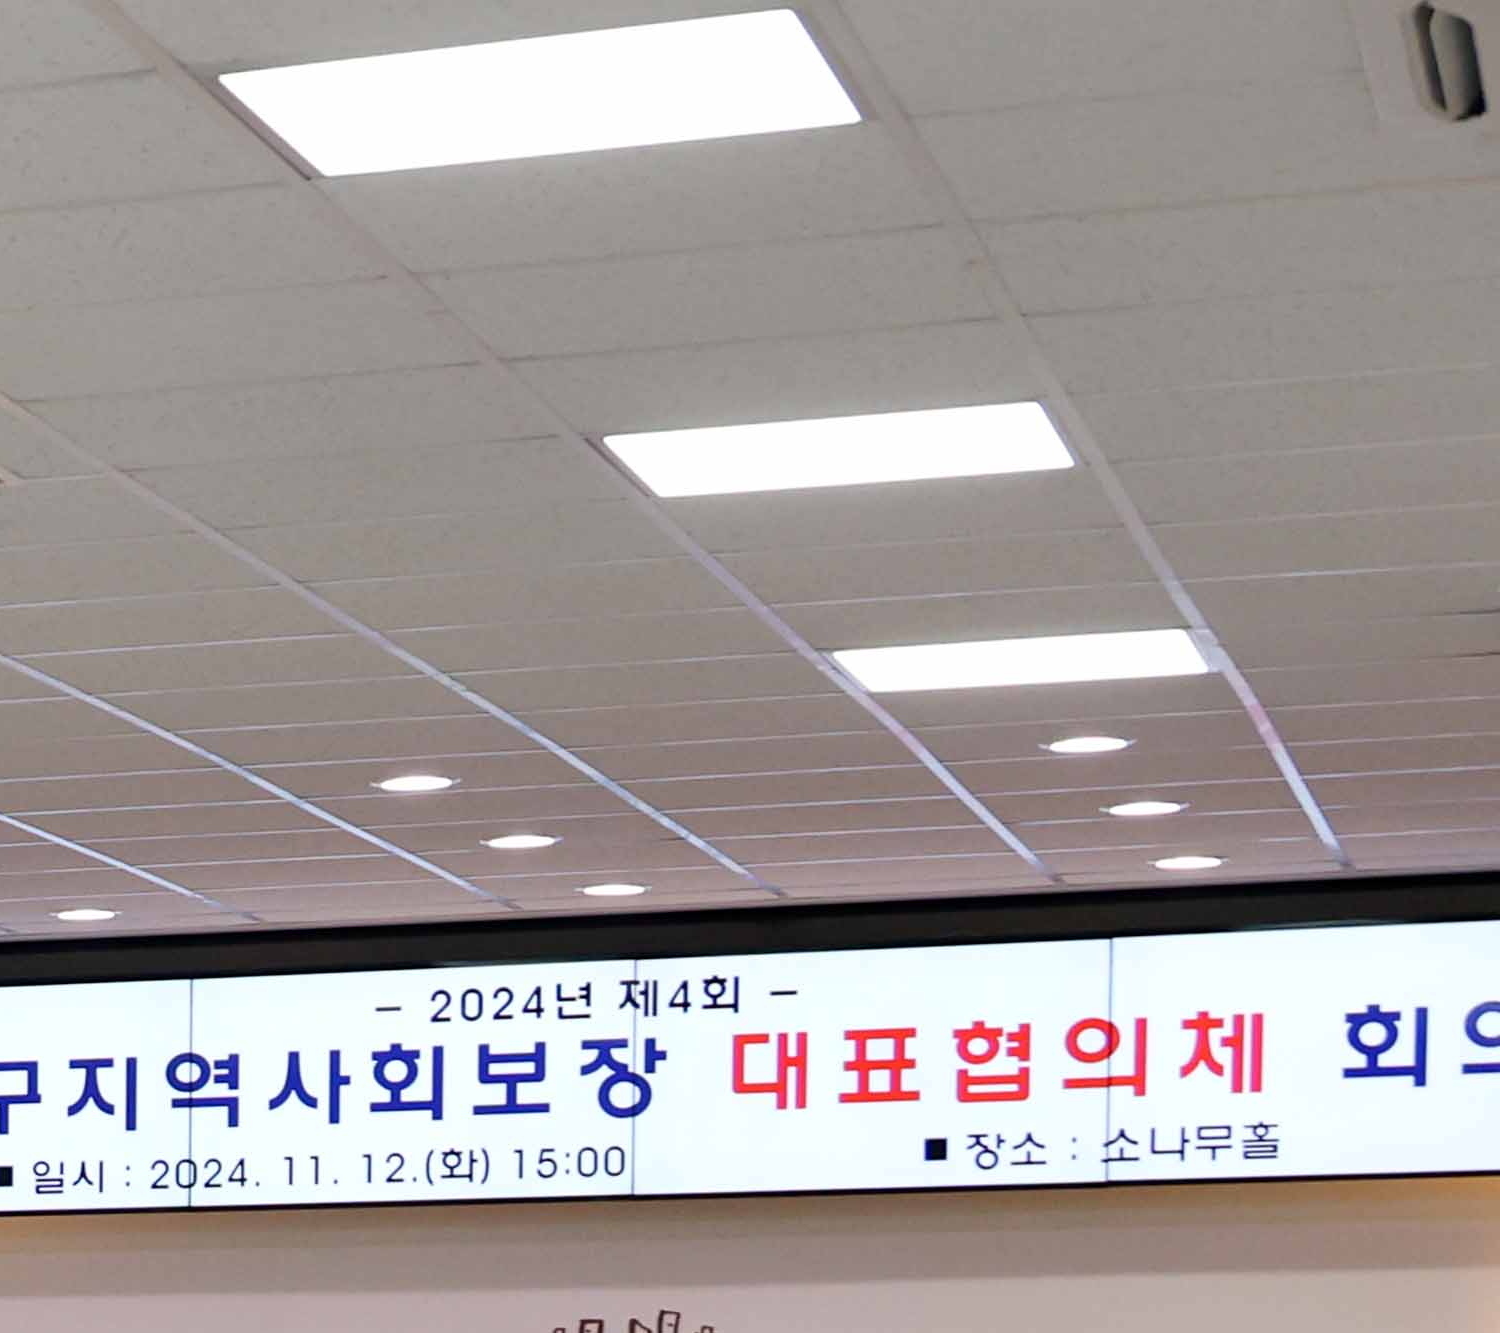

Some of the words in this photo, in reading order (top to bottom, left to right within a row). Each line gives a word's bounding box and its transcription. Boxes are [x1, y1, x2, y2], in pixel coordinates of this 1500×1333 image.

[430, 982, 592, 1023] 2024년
[618, 976, 740, 1018] 제4회
[731, 1011, 1264, 1110] 대표협의체
[966, 1132, 1047, 1170] 장소
[1100, 1121, 1280, 1165] 소나무홀
[32, 1161, 104, 1194] 일시
[150, 1158, 261, 1190] 2024.
[283, 1156, 340, 1186] 11.
[362, 1148, 490, 1185] 12.(화)
[513, 1146, 626, 1179] 15:00
